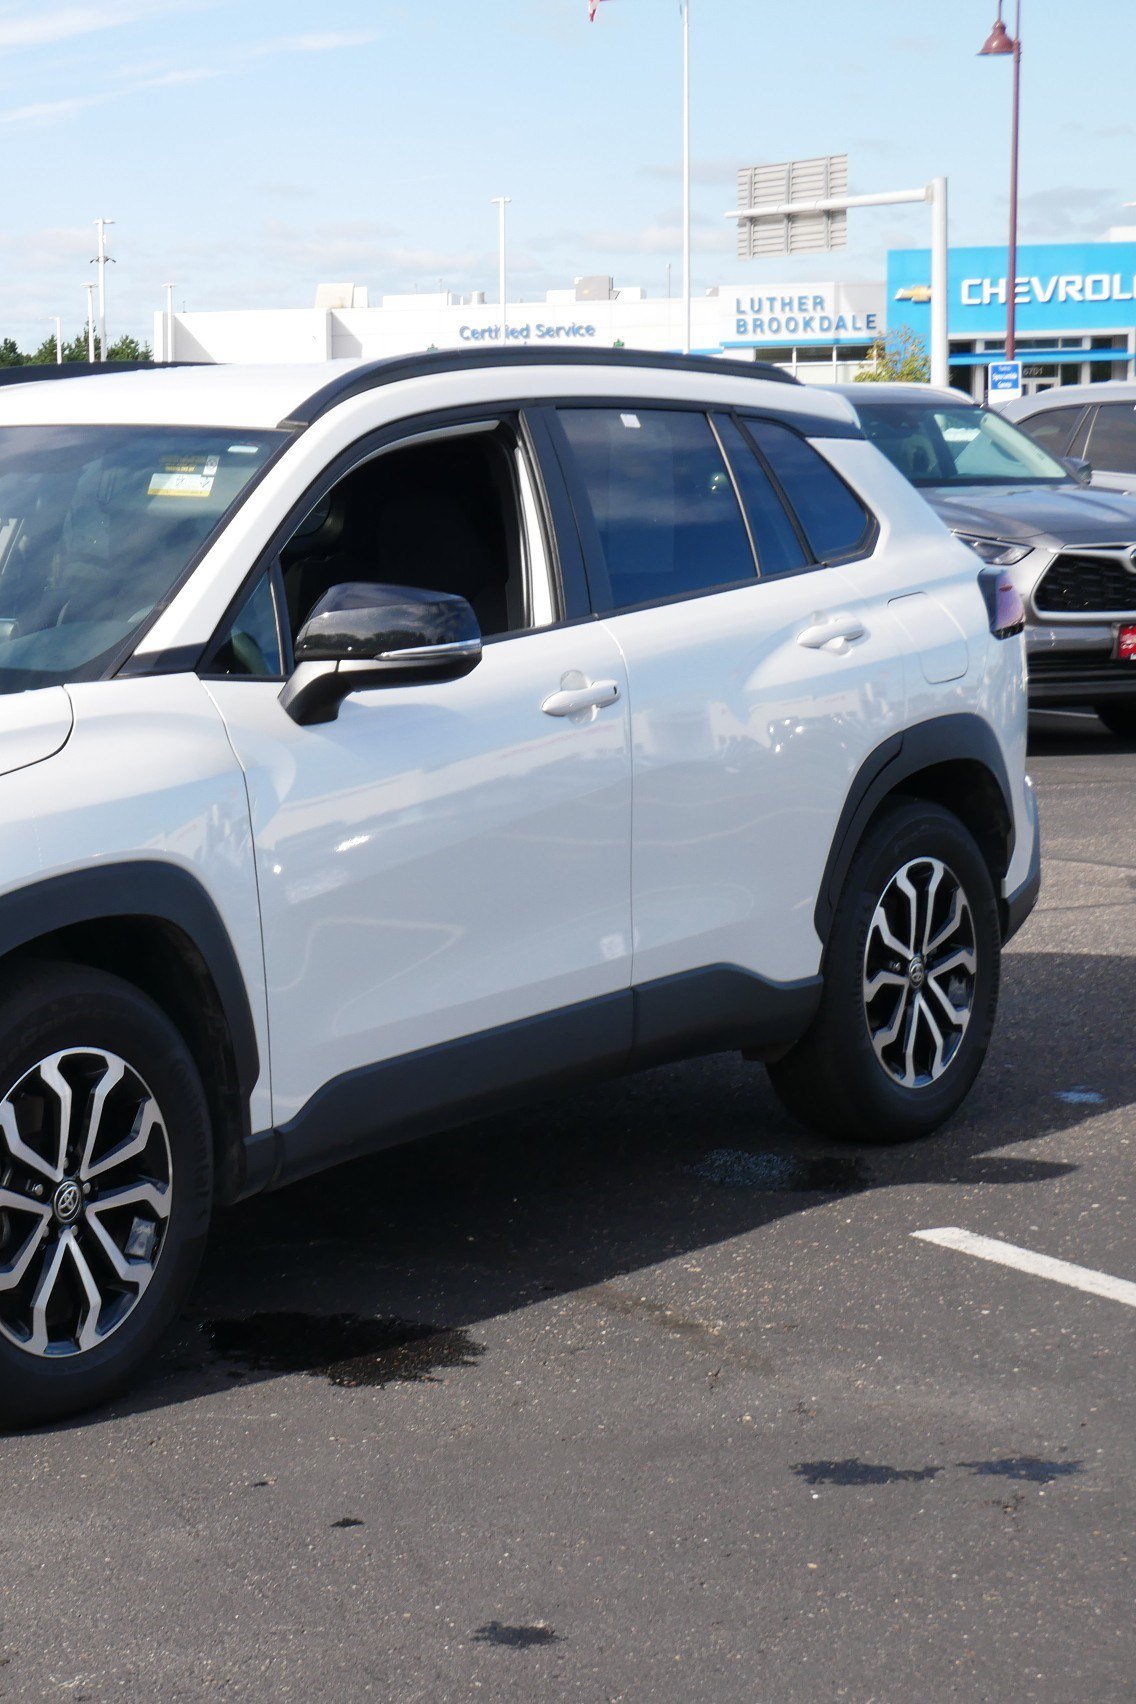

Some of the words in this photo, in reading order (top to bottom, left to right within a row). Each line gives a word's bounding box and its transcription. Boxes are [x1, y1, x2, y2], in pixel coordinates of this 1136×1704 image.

[960, 274, 1136, 305] CHEVROL
[736, 296, 825, 314] LUTHER
[535, 322, 596, 338] Service
[736, 314, 877, 335] BROOKDALE
